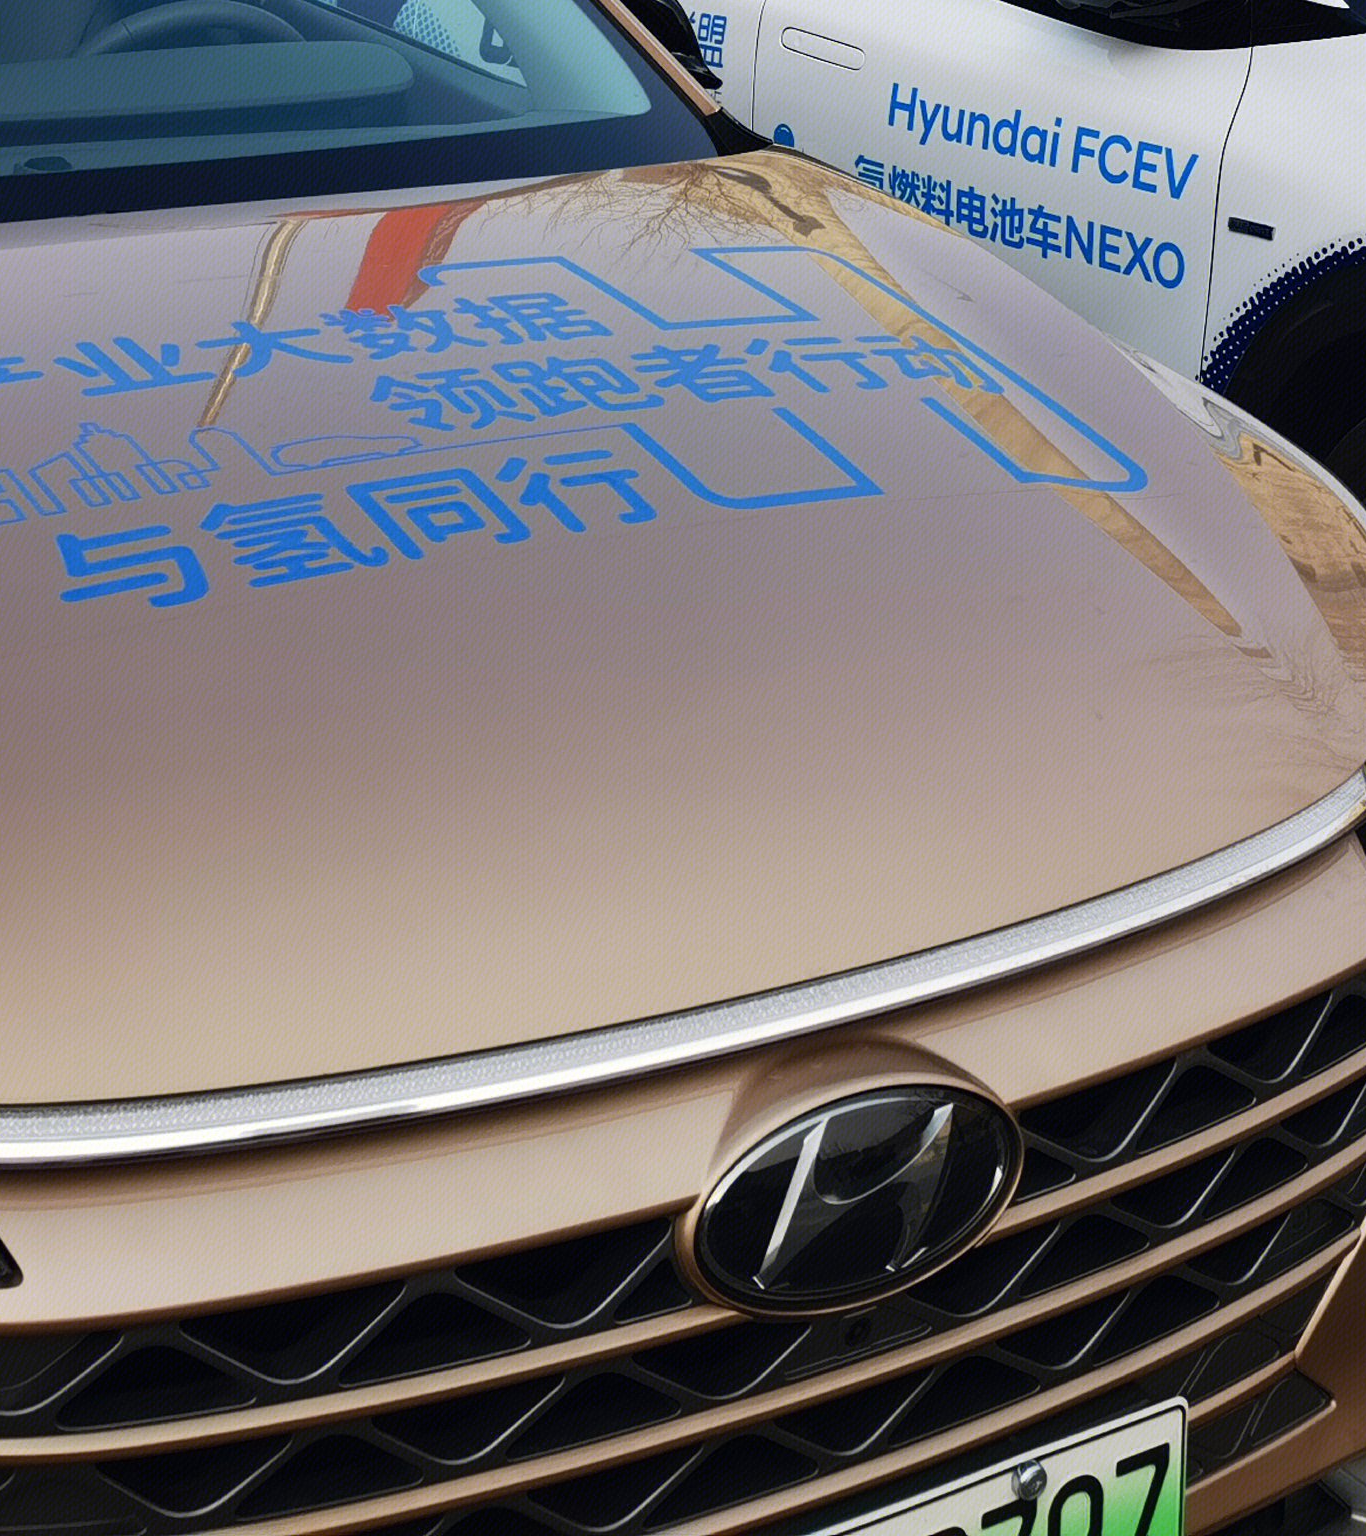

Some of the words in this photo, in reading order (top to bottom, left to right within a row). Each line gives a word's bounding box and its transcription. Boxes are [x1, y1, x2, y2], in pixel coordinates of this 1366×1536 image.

[689, 11, 727, 69] 盟
[887, 82, 1063, 167] Hyundai
[1071, 126, 1200, 200] FCEV
[369, 334, 1006, 433] 领跑者行动
[55, 448, 657, 608] 与氢同行
